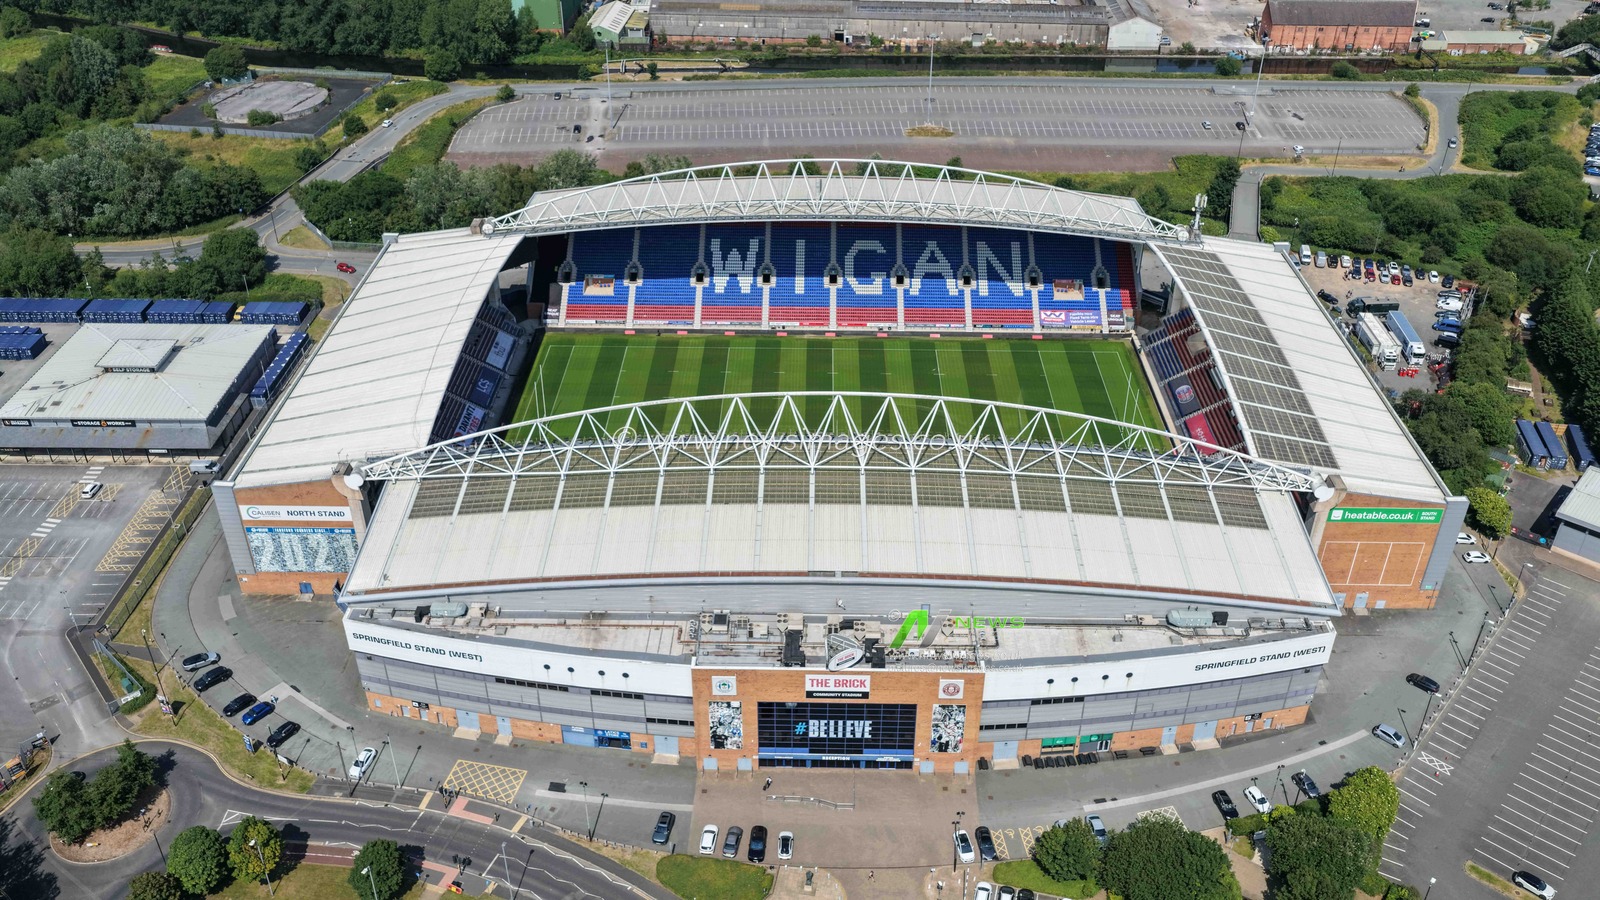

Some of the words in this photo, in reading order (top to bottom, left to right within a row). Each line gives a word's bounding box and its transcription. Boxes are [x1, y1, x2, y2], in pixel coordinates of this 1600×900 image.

[710, 238, 1024, 296] WIGAN
[459, 404, 476, 432] DAVANTI
[317, 510, 346, 518] STAND
[1344, 511, 1414, 520] heatable.co.uk
[352, 632, 412, 650] SPRINGFIELD
[414, 644, 446, 656] STAND
[448, 650, 483, 662] (WEST)
[1194, 657, 1257, 671] SPRINGFIELD
[1259, 652, 1291, 663] STAND
[1293, 646, 1326, 658] (WEST)
[809, 678, 831, 688] THE
[833, 678, 867, 688] BRICK
[794, 719, 873, 738] #BELIEVE
